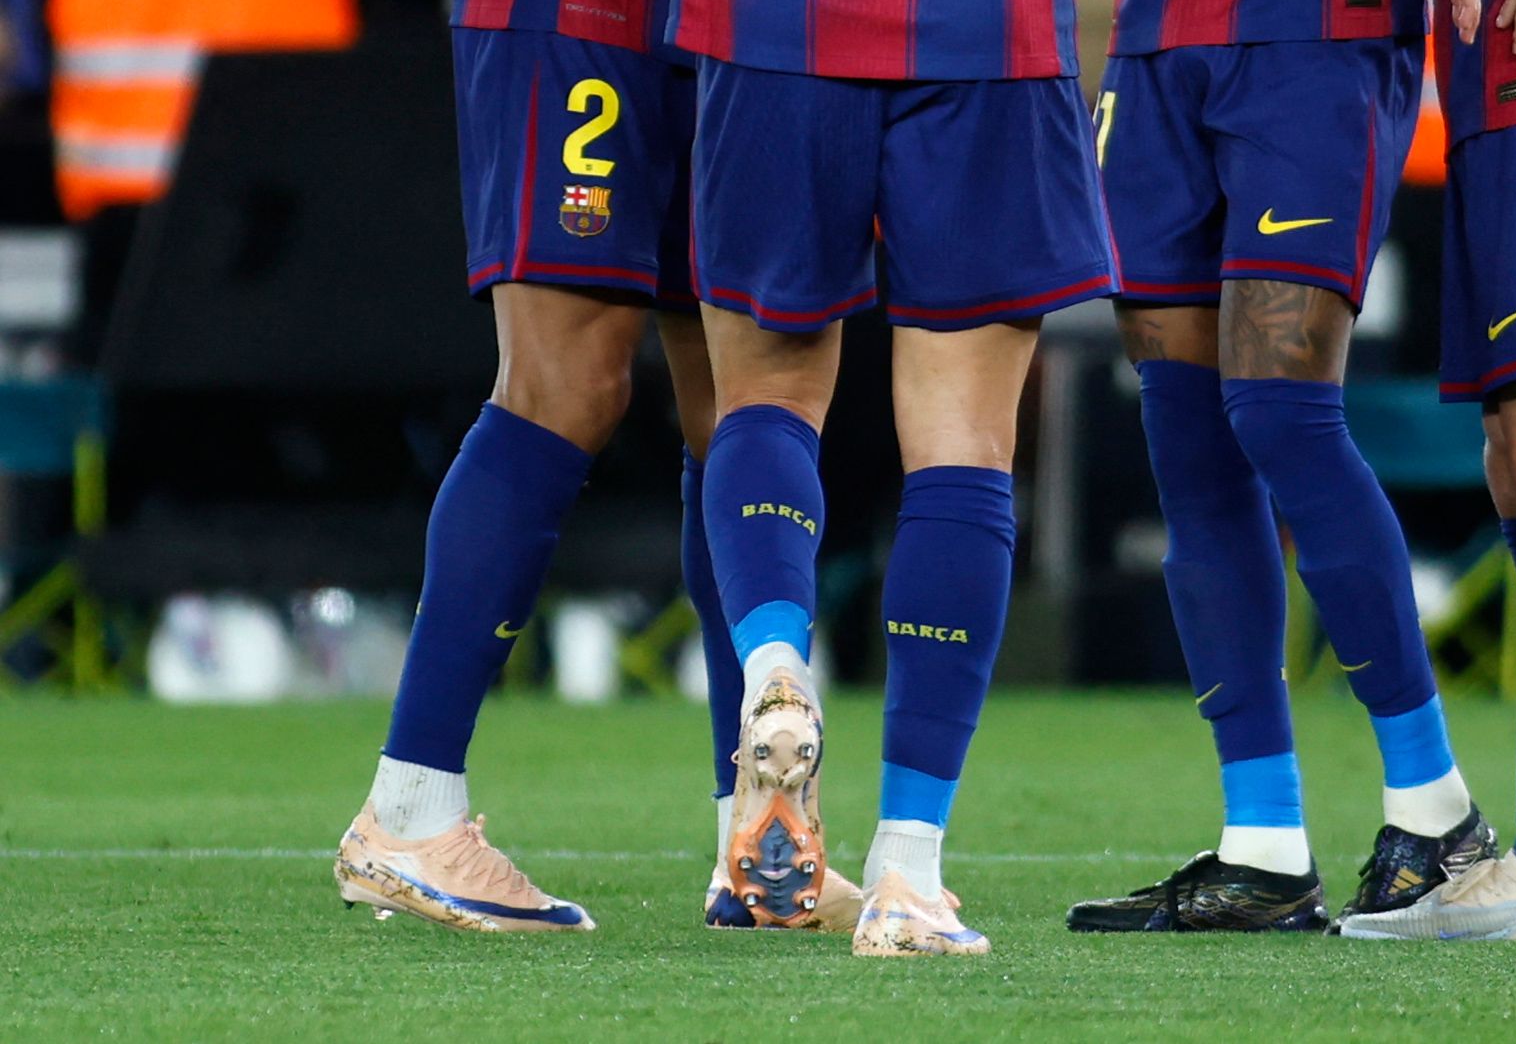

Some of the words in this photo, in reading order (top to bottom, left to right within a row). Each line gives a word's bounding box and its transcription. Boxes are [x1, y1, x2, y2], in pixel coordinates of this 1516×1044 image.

[562, 78, 619, 177] 2
[742, 503, 816, 536] BARÇA
[887, 620, 968, 644] BARÇA
